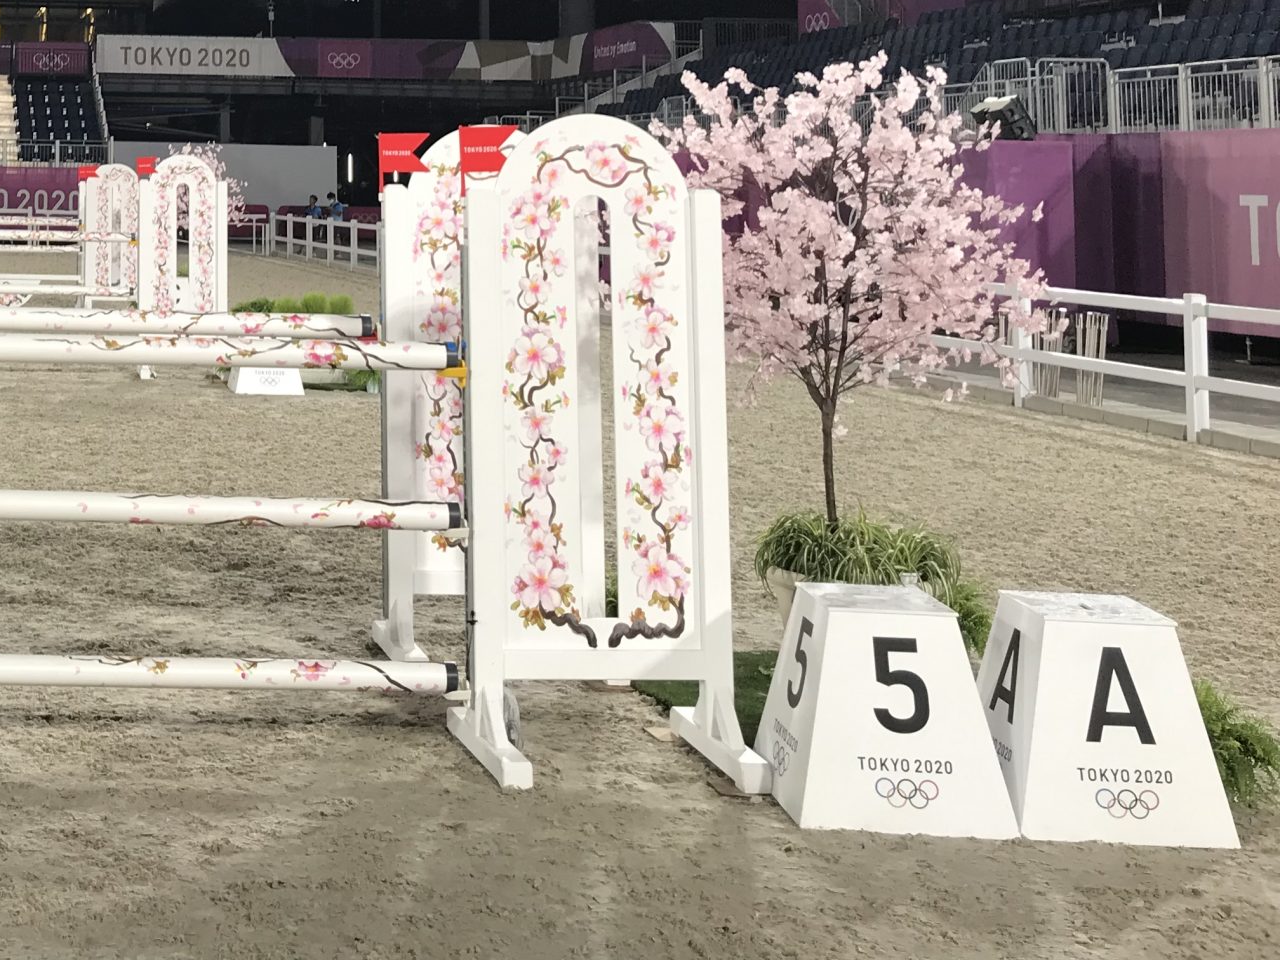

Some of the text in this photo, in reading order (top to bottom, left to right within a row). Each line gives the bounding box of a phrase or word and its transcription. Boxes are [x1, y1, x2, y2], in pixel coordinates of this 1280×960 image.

[120, 46, 250, 67] TOKYO 2020
[483, 145, 497, 153] 2020
[1239, 194, 1280, 266] T
[787, 616, 814, 709] 5
[872, 636, 930, 734] 5
[989, 628, 1021, 725] A
[1086, 646, 1157, 745] A
[774, 718, 798, 753] TOKYO 2020
[857, 756, 953, 774] TOKYO 2020
[1077, 767, 1173, 784] TOKYO 2020
